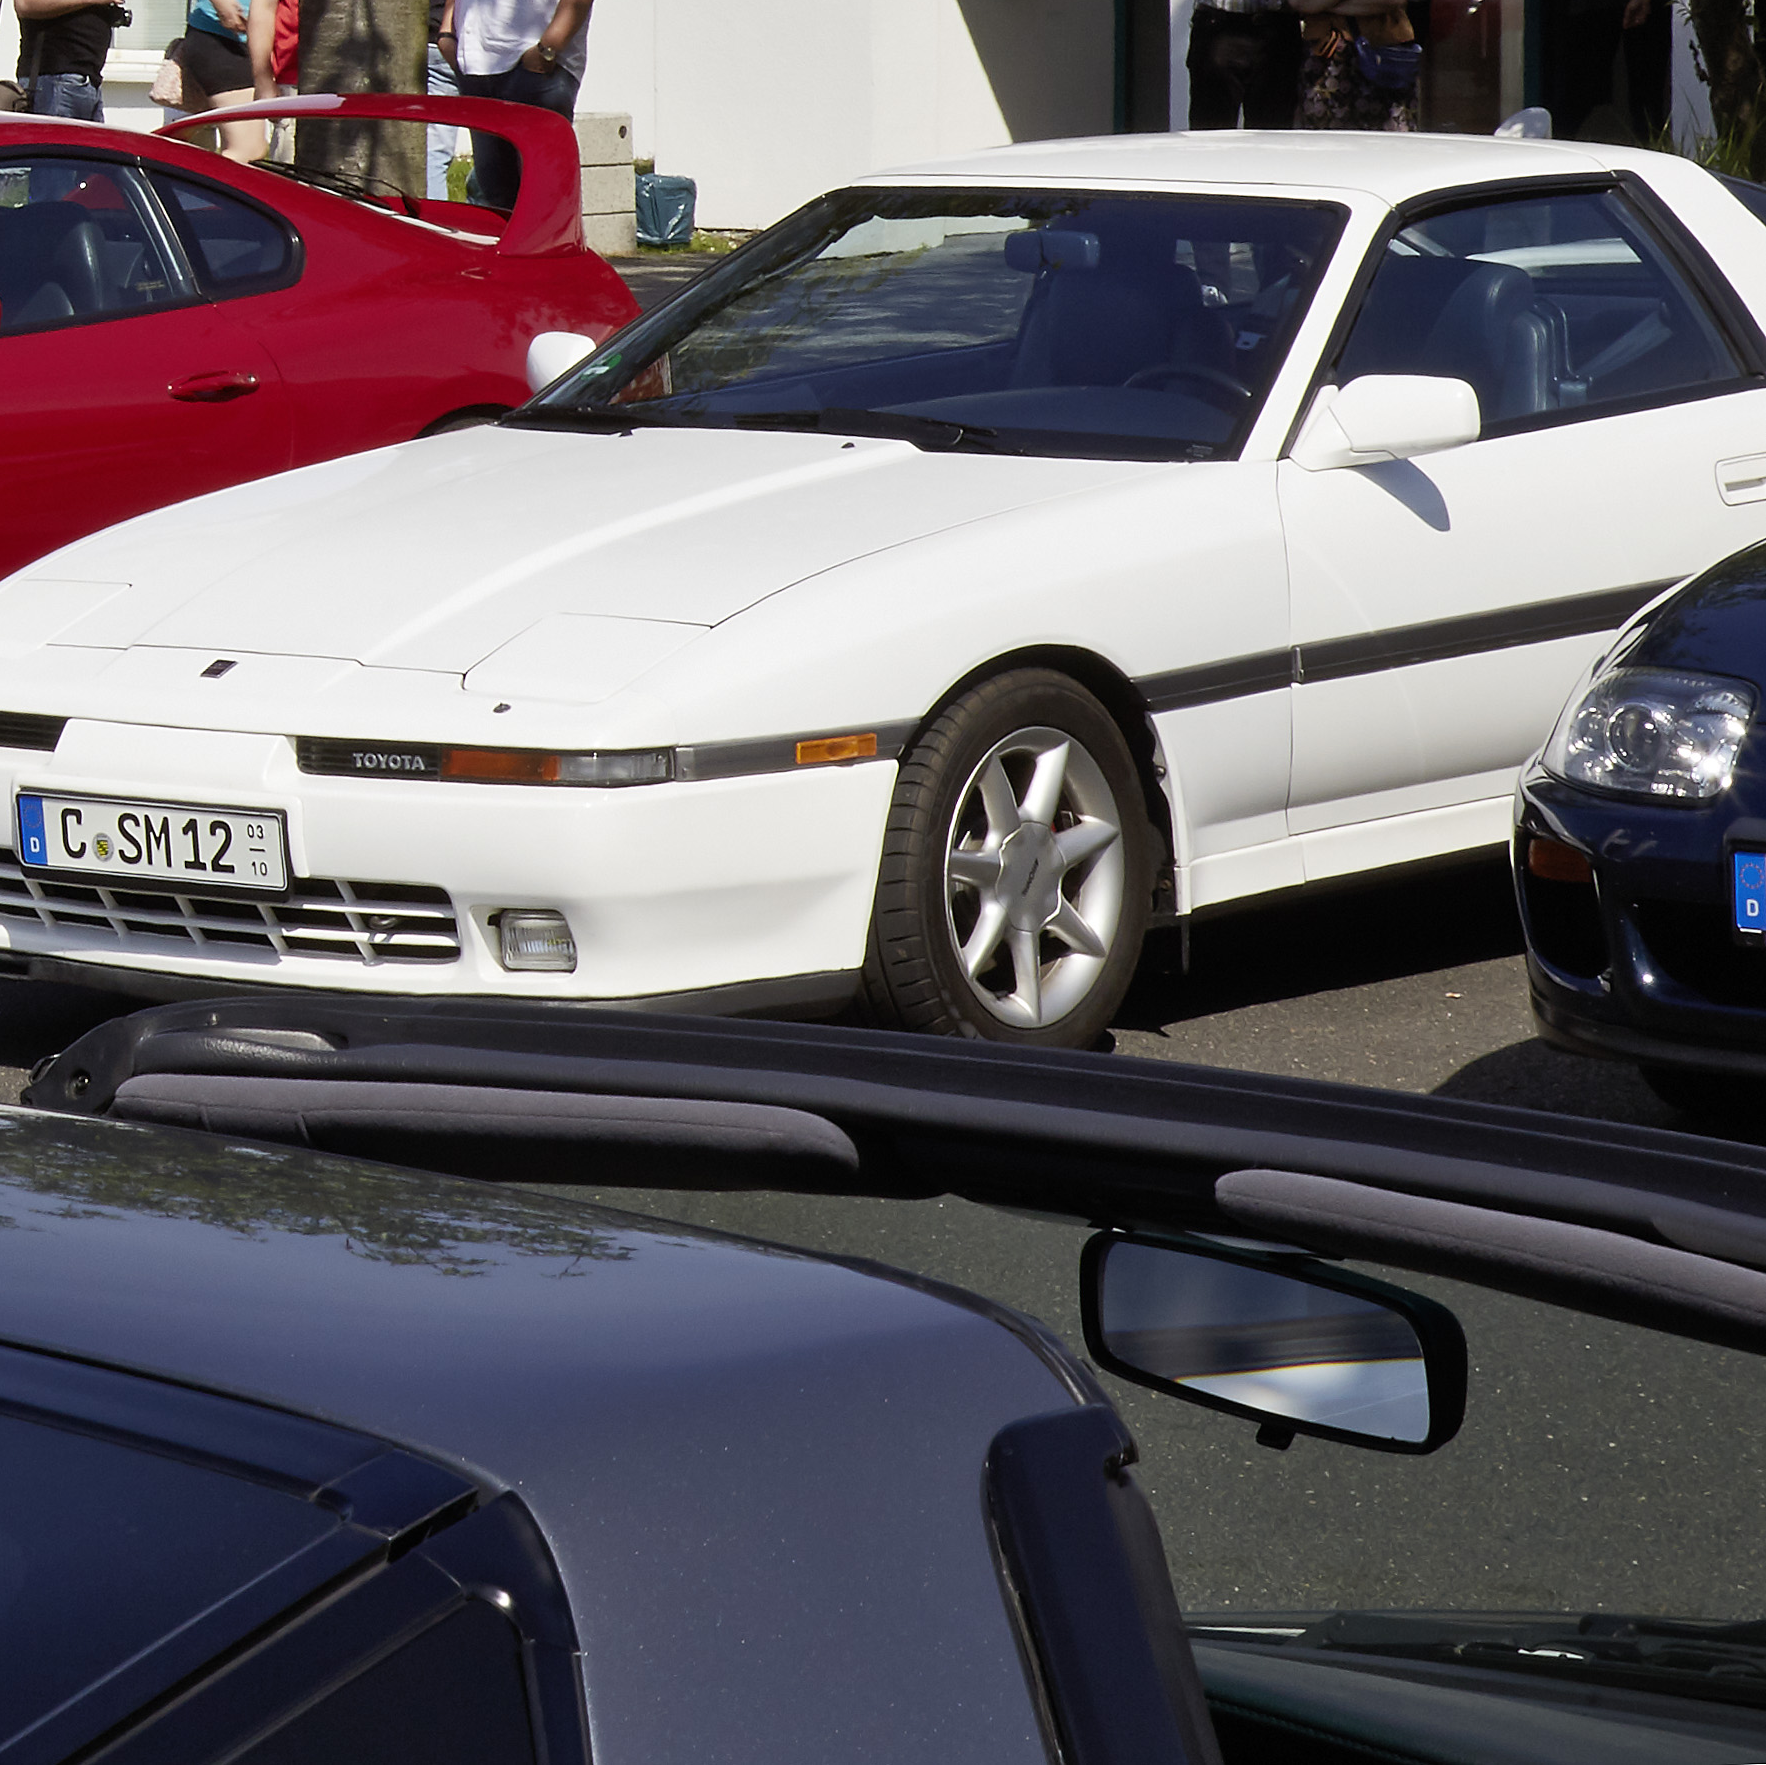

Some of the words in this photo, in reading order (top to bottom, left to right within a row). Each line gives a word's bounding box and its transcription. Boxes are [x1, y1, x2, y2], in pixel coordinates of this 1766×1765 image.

[352, 752, 425, 771] TOYOTA
[61, 807, 87, 859] C
[118, 812, 172, 868] SM
[182, 818, 236, 874] 12
[247, 823, 264, 840] 03
[29, 836, 40, 853] D
[251, 860, 268, 876] 10
[1746, 898, 1760, 917] D
